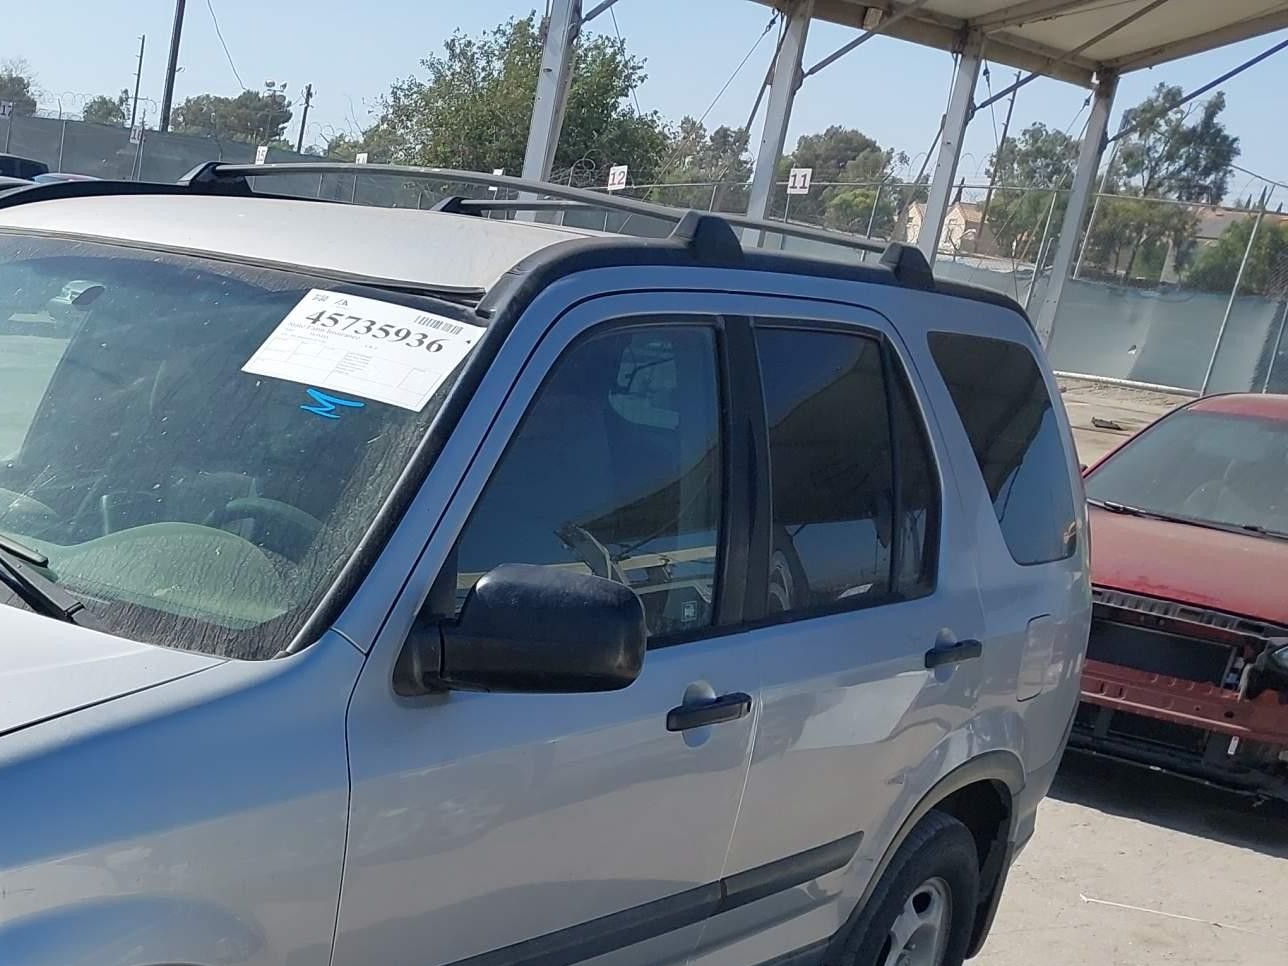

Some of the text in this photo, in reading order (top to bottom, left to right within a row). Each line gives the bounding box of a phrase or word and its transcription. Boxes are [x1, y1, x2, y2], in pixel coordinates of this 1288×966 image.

[0, 103, 12, 117] 17
[609, 170, 626, 186] 12
[789, 173, 808, 190] 11
[305, 310, 448, 352] 45735936
